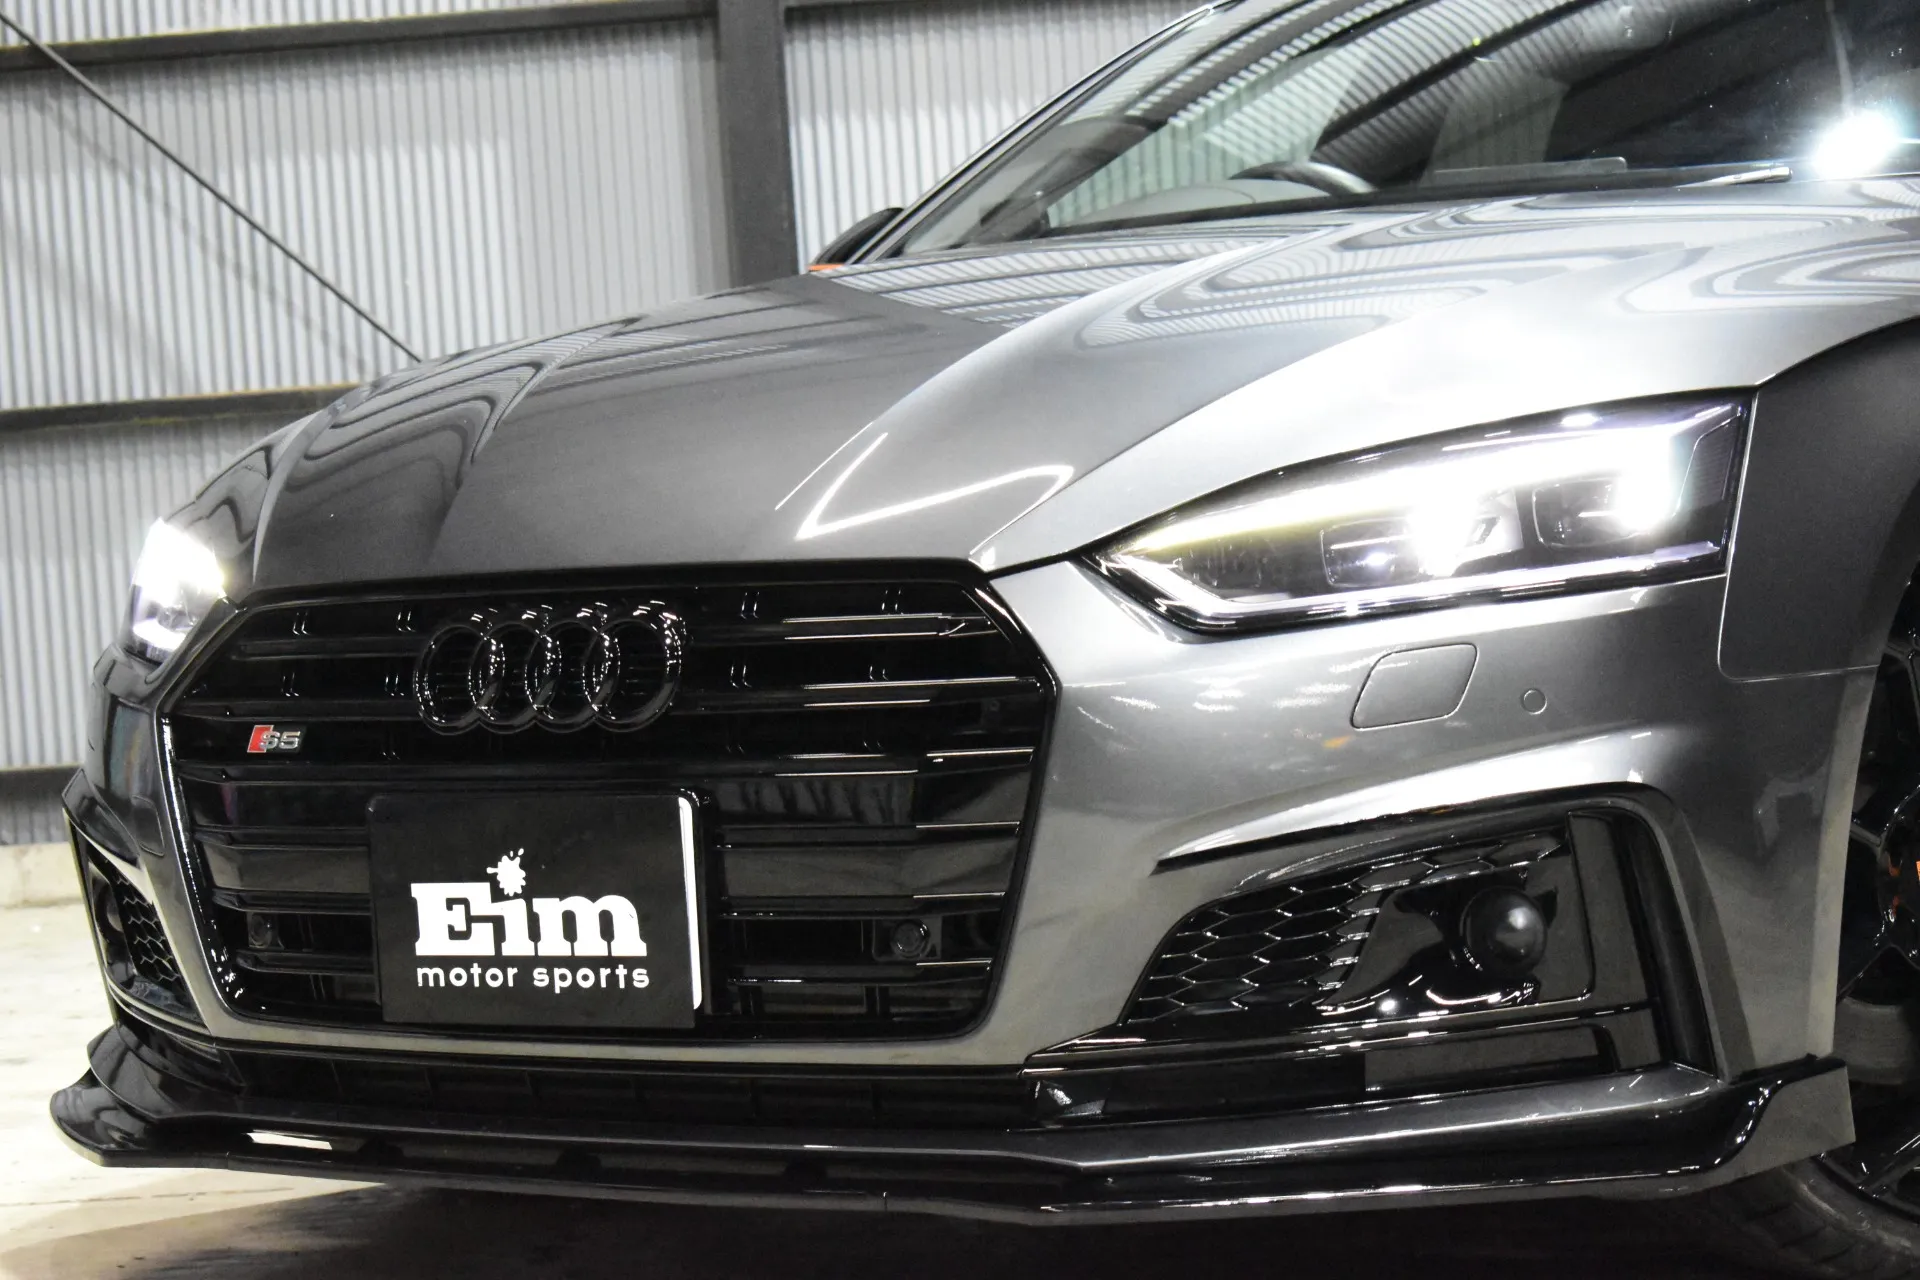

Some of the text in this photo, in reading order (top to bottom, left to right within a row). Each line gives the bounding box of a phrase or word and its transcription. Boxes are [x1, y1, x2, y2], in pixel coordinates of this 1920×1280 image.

[258, 730, 301, 750] S5
[411, 848, 647, 957] Eim
[416, 963, 650, 994] motor sports
